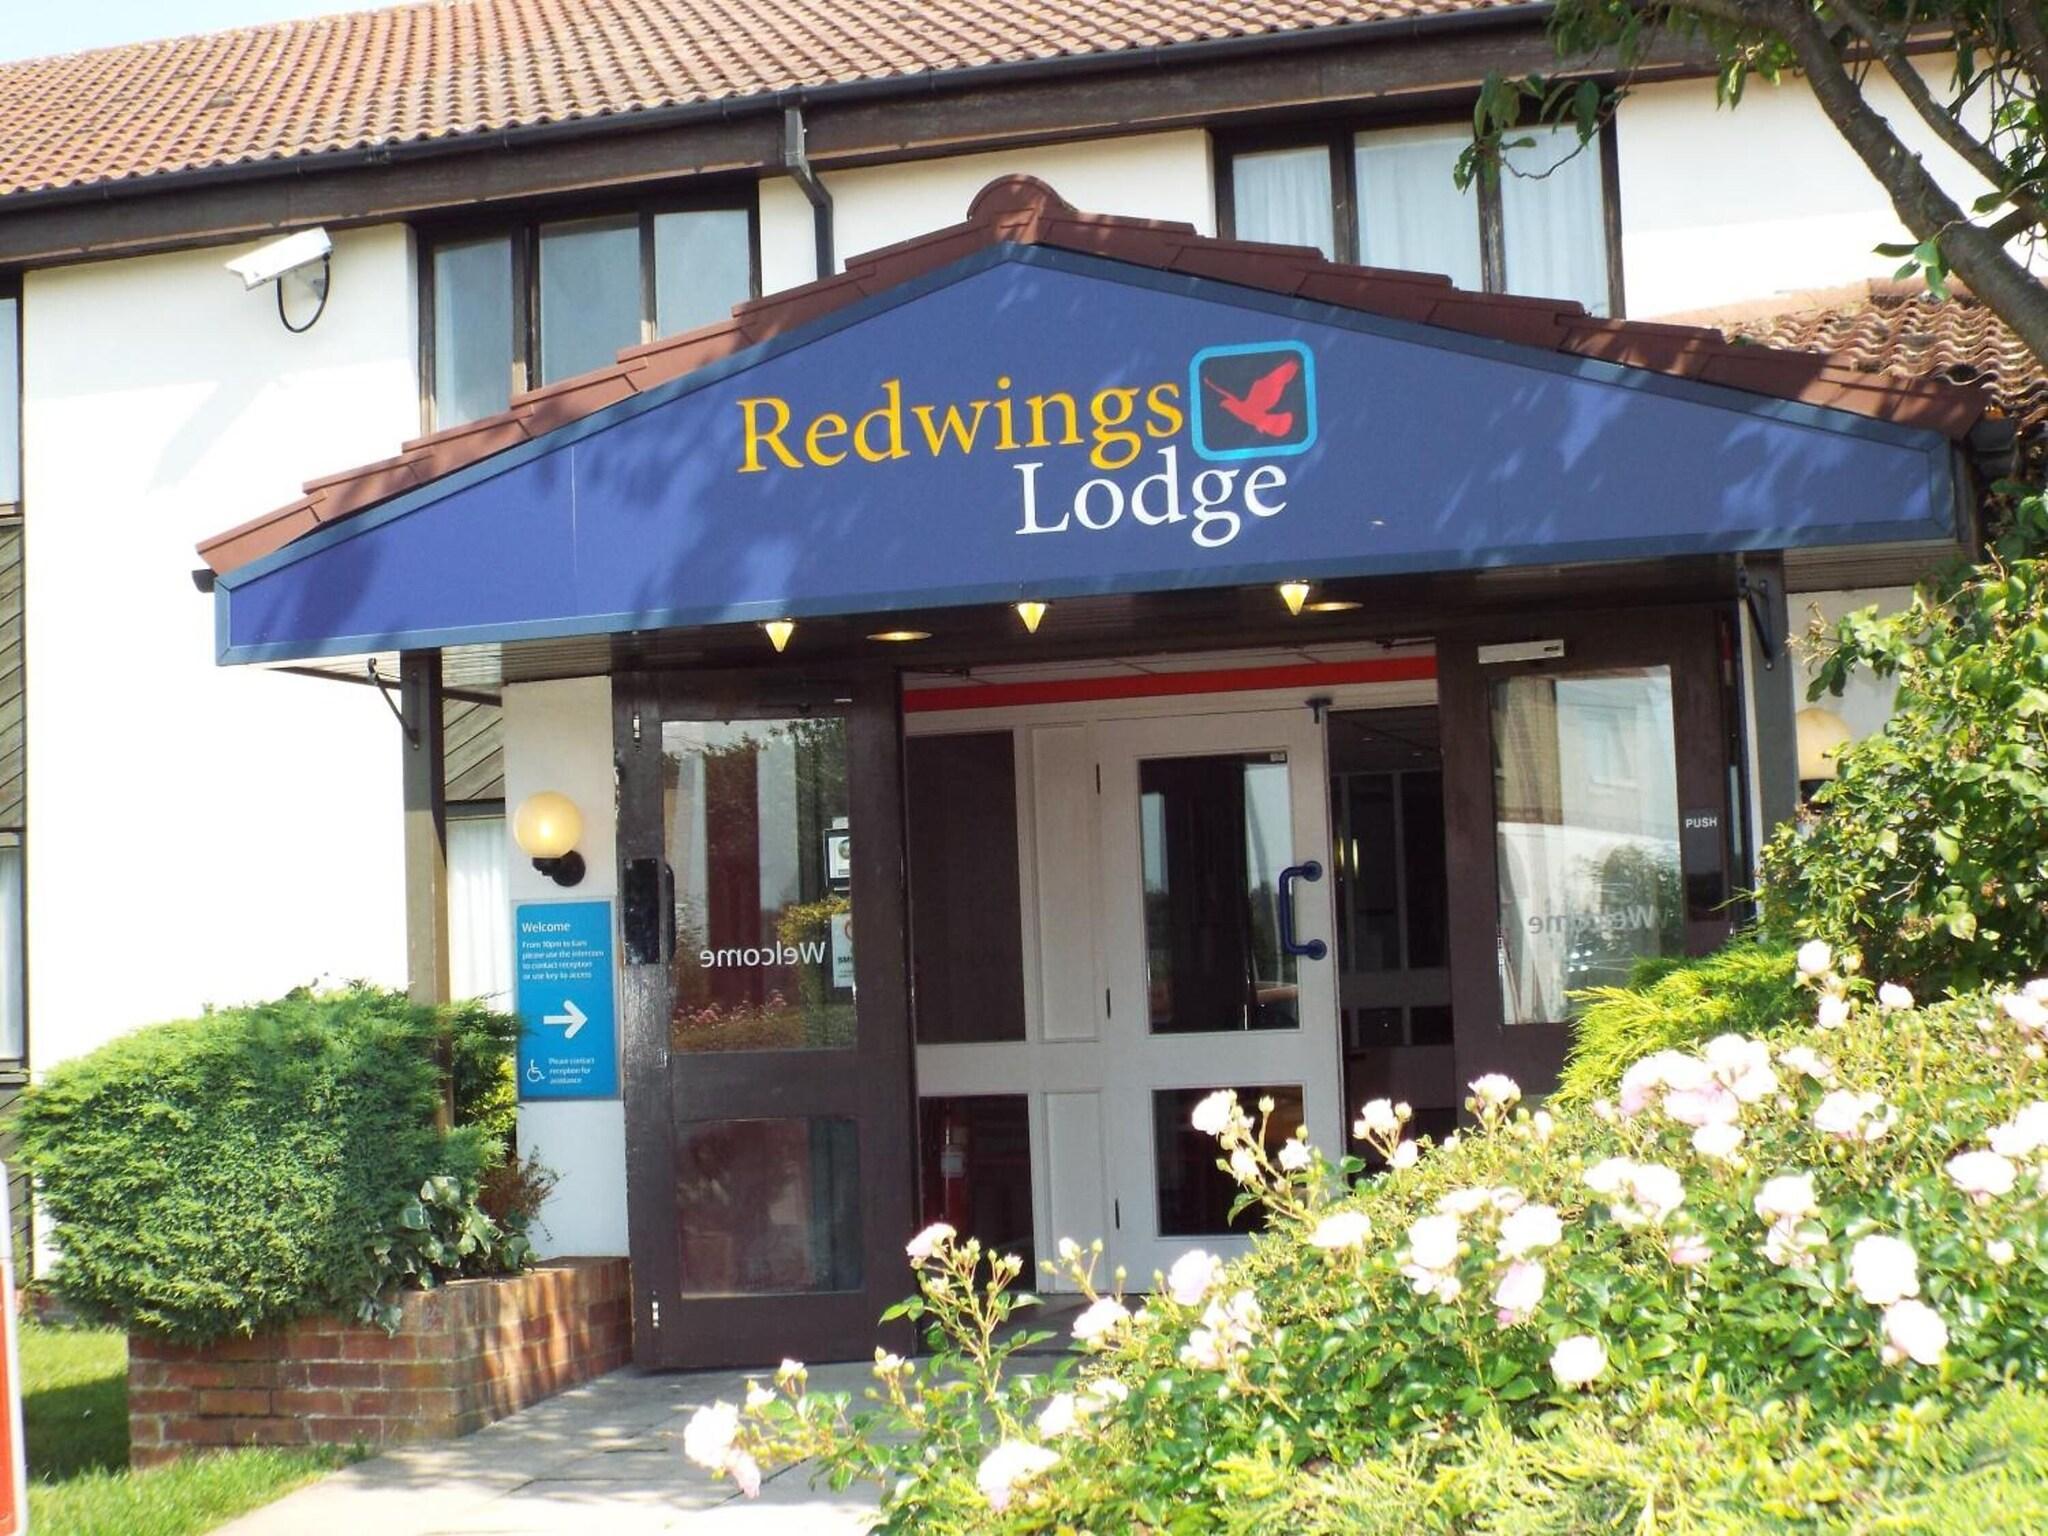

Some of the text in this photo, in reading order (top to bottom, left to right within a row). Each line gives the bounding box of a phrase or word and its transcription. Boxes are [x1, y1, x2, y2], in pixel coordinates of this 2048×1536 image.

[736, 376, 1184, 471] Redwings
[1013, 444, 1288, 548] Lodge
[1685, 816, 1718, 829] PUSH
[522, 921, 571, 934] Welcome
